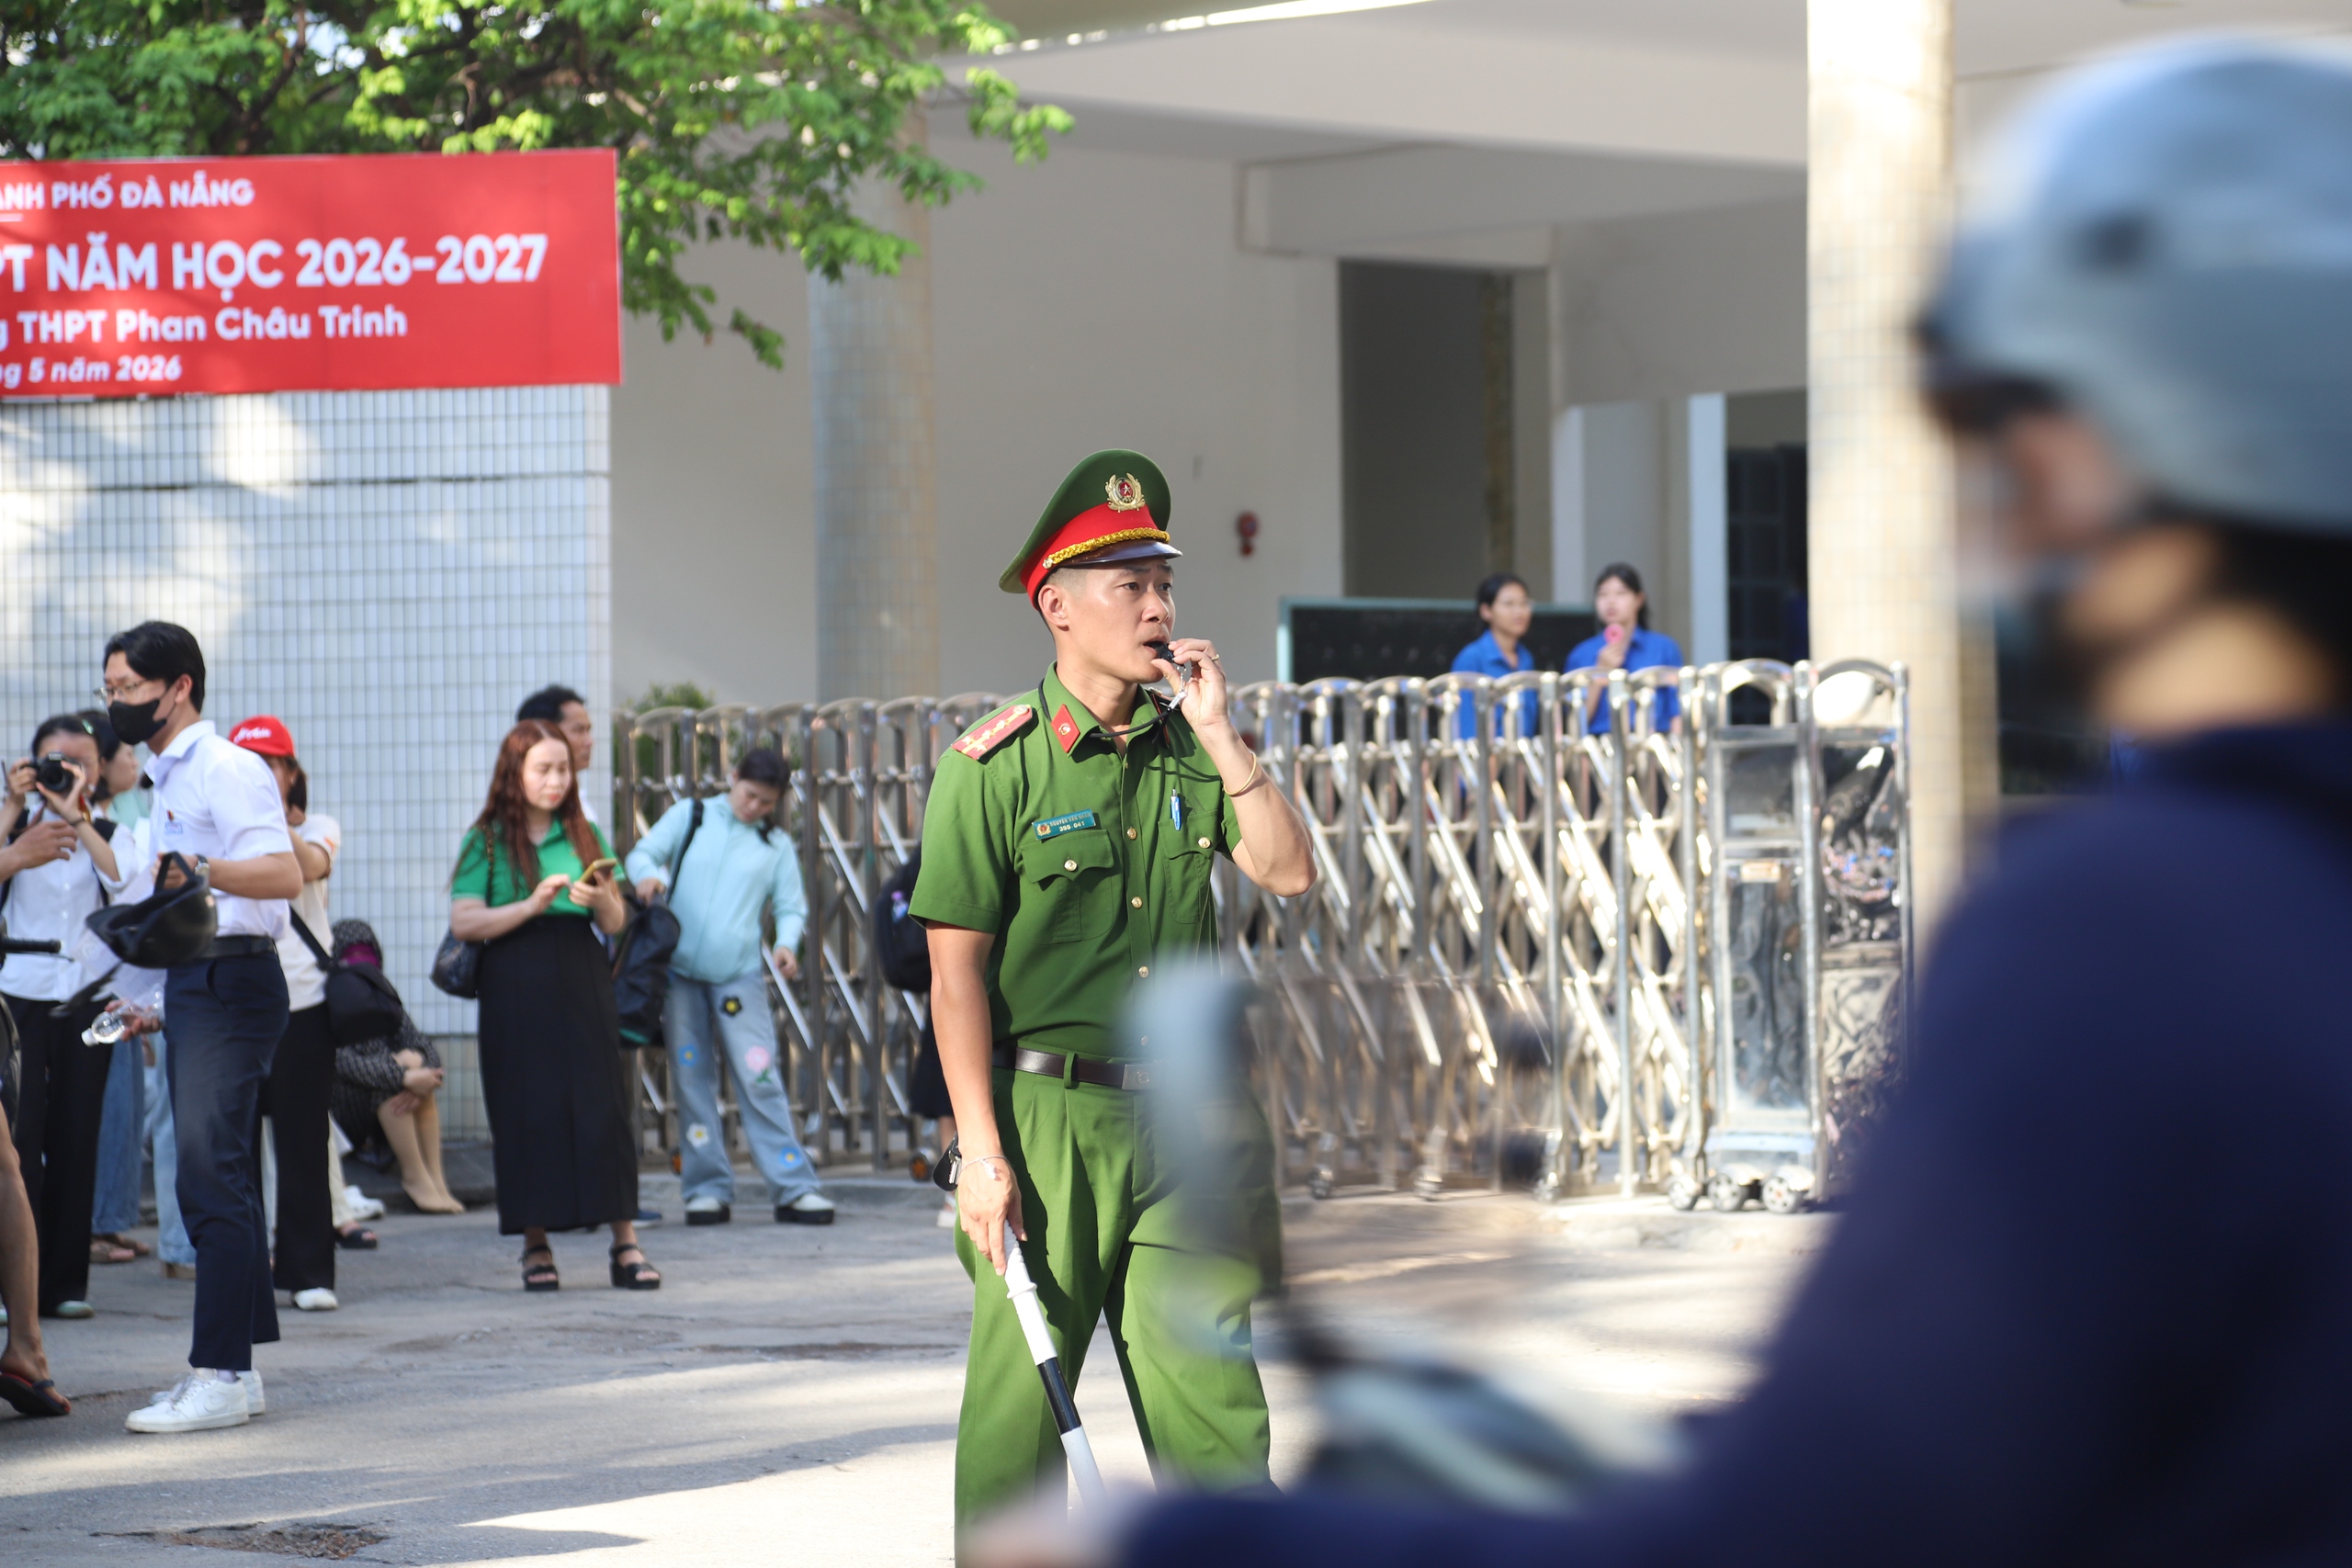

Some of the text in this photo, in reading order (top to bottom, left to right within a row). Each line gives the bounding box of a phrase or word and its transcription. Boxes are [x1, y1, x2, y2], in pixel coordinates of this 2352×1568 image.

[0, 170, 255, 210] NH PHỐ ĐÀ NẴNG
[0, 231, 548, 303] T NĂM HỌC 2026-2027
[17, 309, 107, 344] THPT
[116, 308, 207, 343] Phan
[214, 306, 311, 341] Châu
[318, 304, 408, 338] Trinh
[0, 355, 182, 389] g 5 năm 2026
